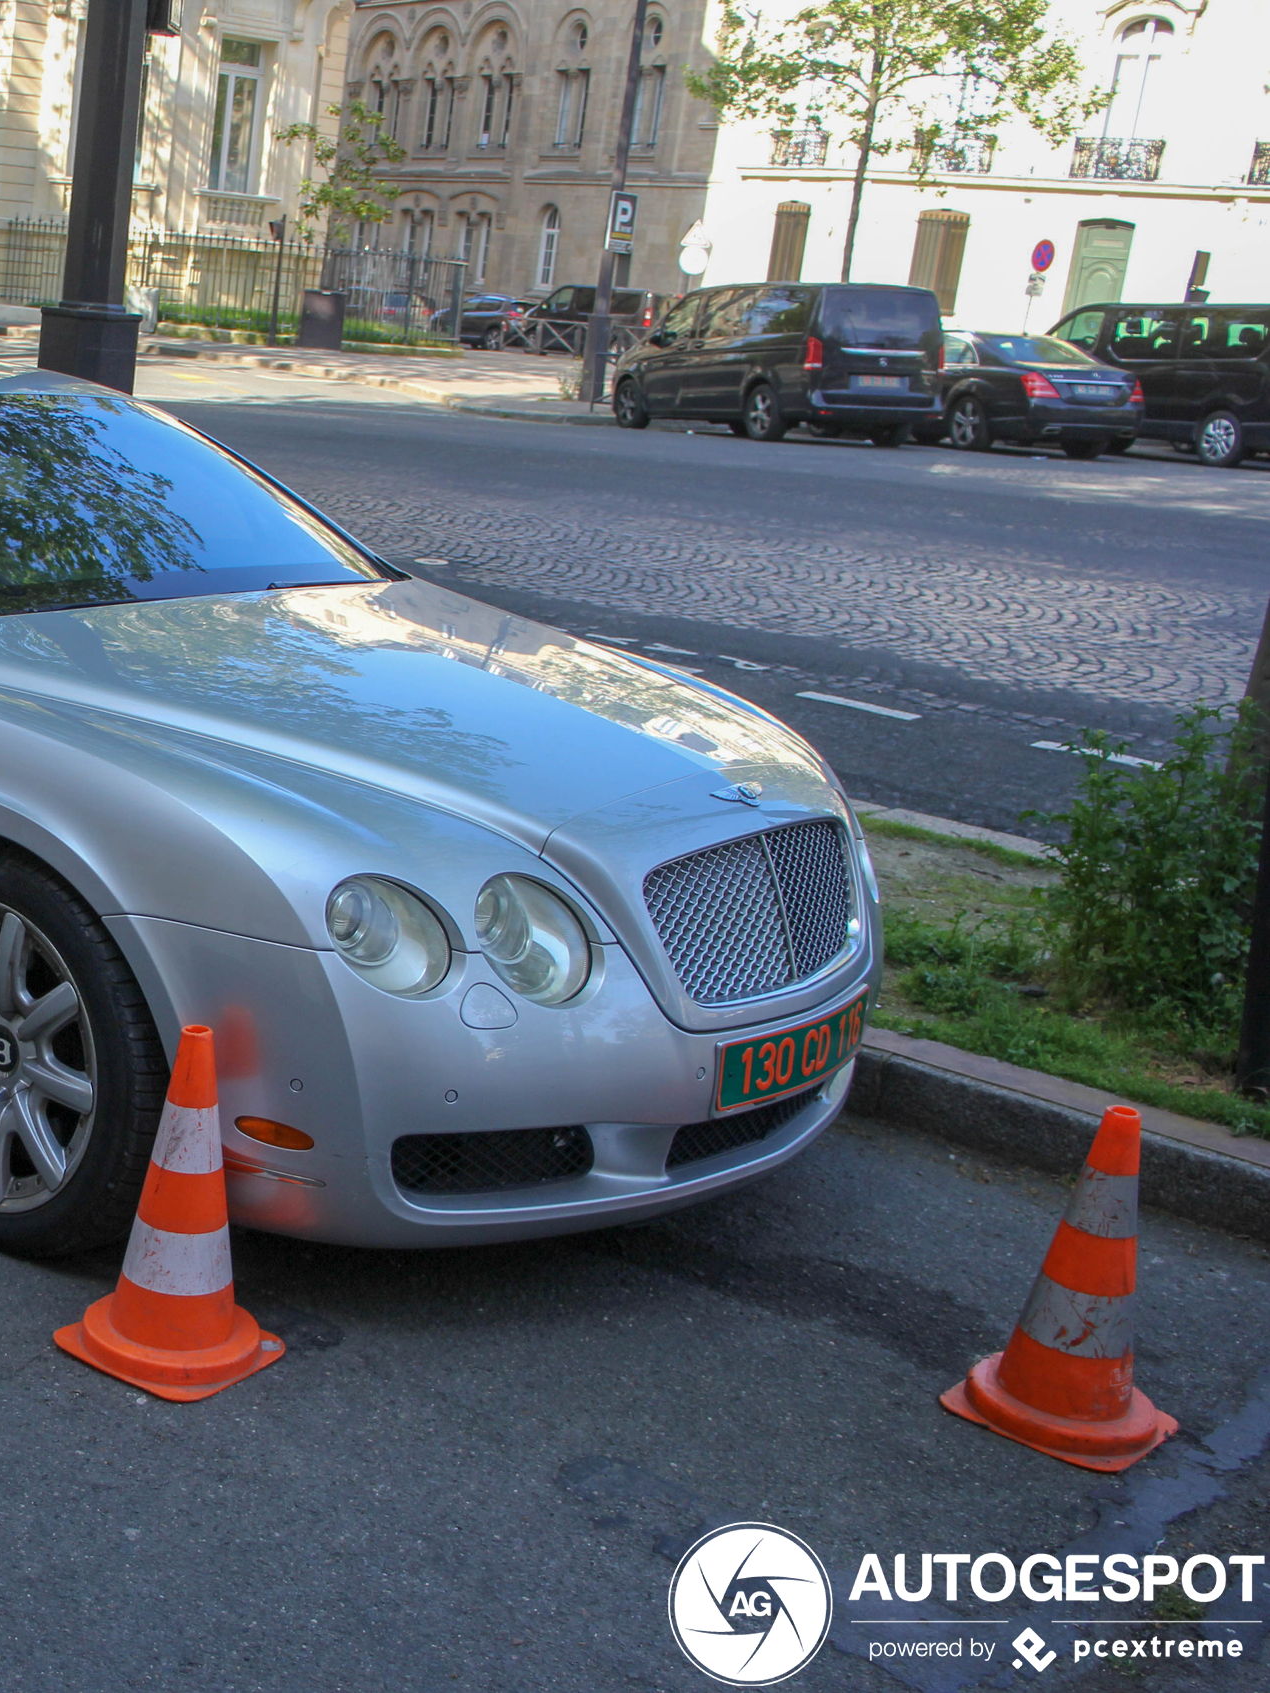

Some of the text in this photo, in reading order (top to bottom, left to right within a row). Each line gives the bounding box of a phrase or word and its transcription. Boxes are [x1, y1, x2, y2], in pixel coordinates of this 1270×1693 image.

[614, 200, 633, 232] P
[741, 1001, 864, 1095] 130 CD 116
